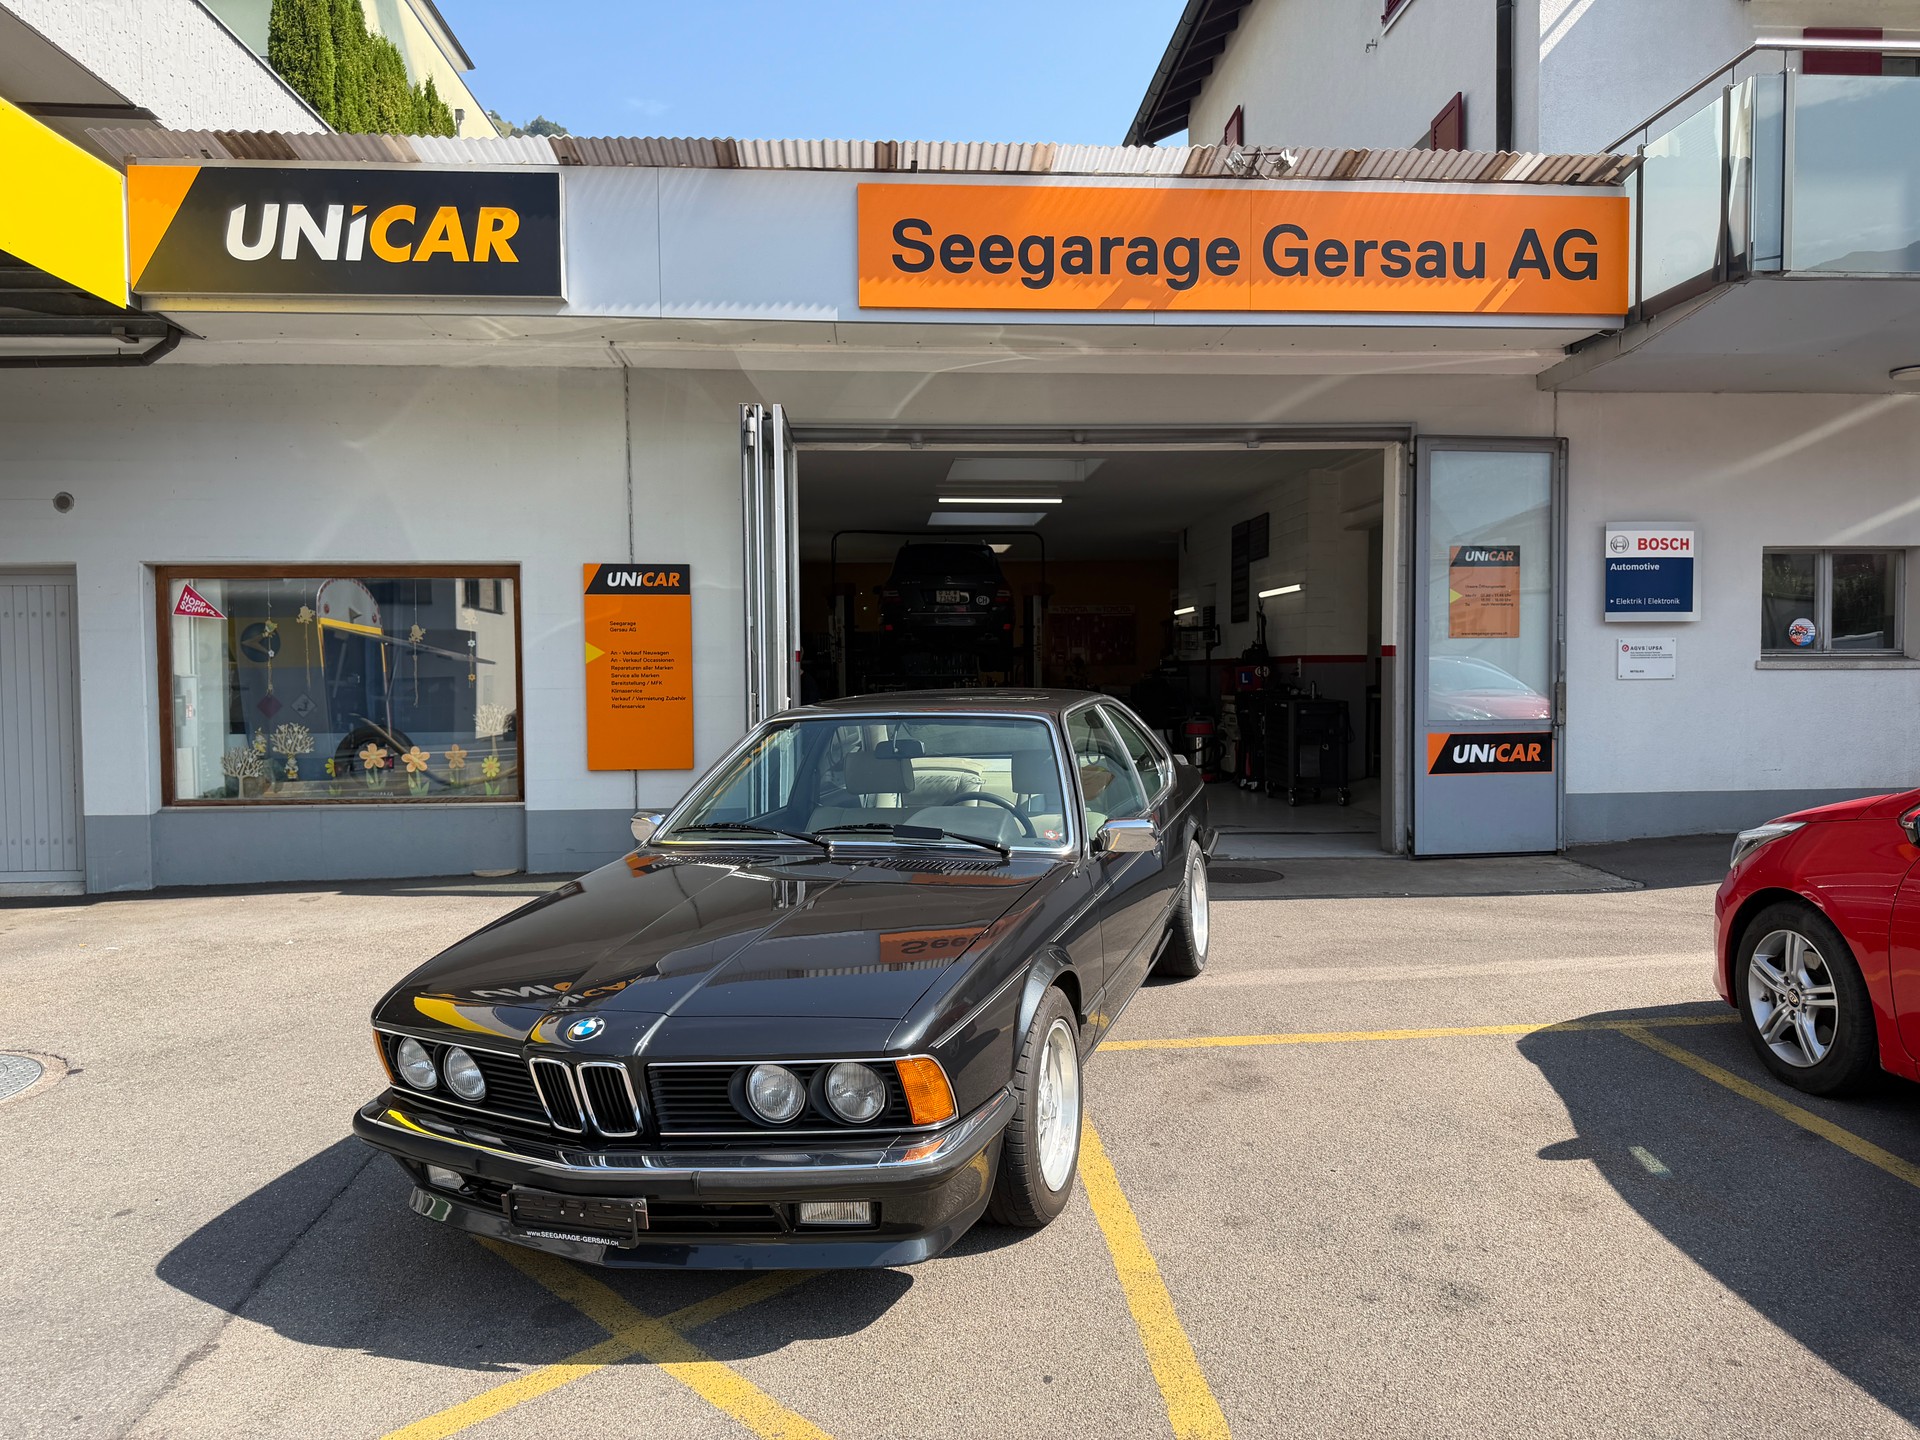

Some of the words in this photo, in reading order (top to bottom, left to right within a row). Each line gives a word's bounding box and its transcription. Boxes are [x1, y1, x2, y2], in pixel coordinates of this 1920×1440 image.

[892, 218, 1241, 290] Seegarage
[1262, 223, 1486, 280] Gersau
[1507, 228, 1598, 281] AG
[1637, 537, 1690, 551] BOSCH
[1610, 562, 1660, 571] Automotive
[183, 592, 206, 607] HOPP
[1616, 597, 1642, 605] Elektrik
[1647, 597, 1680, 605] Elektronik
[180, 601, 216, 617] SCHWYZ
